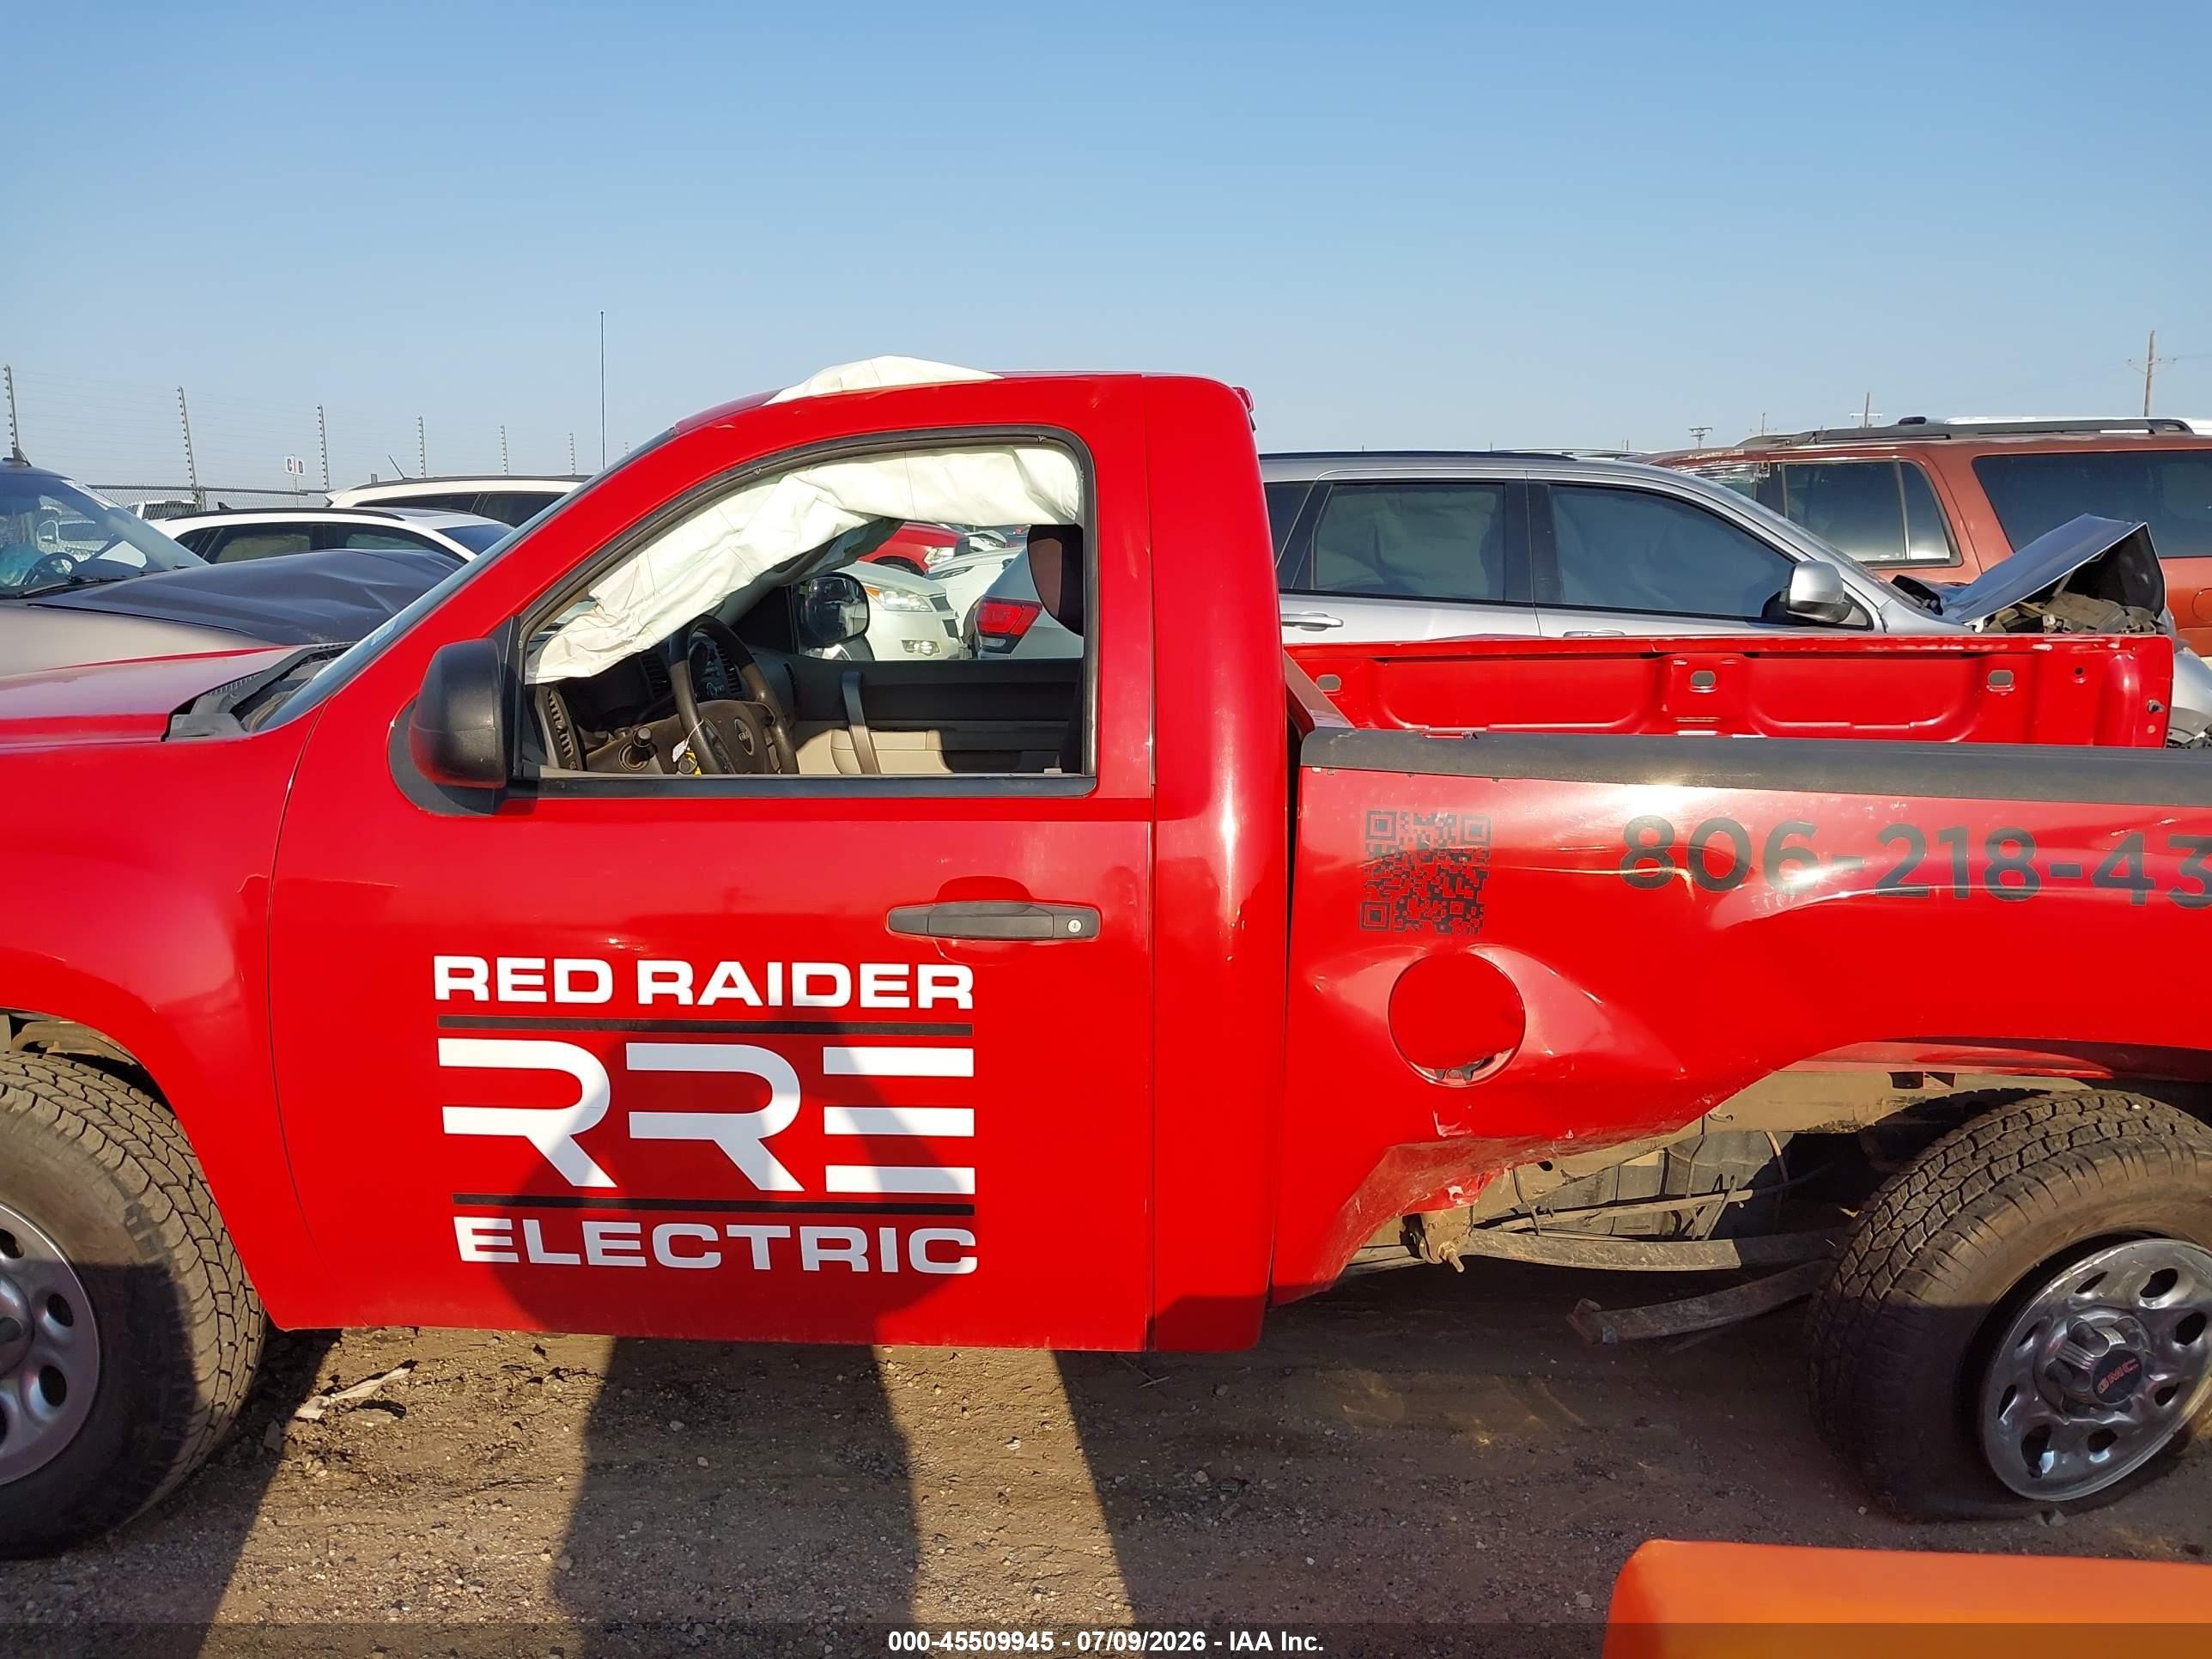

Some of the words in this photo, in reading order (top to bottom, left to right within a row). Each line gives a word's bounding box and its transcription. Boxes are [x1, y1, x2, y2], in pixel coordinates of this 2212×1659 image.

[287, 458, 293, 472] C
[298, 460, 304, 474] D
[434, 955, 613, 1004] RED
[636, 960, 974, 1010] RAIDER
[438, 1037, 975, 1195] RRE
[453, 1216, 978, 1274] ELECTRIC
[2097, 1358, 2139, 1395] GMC
